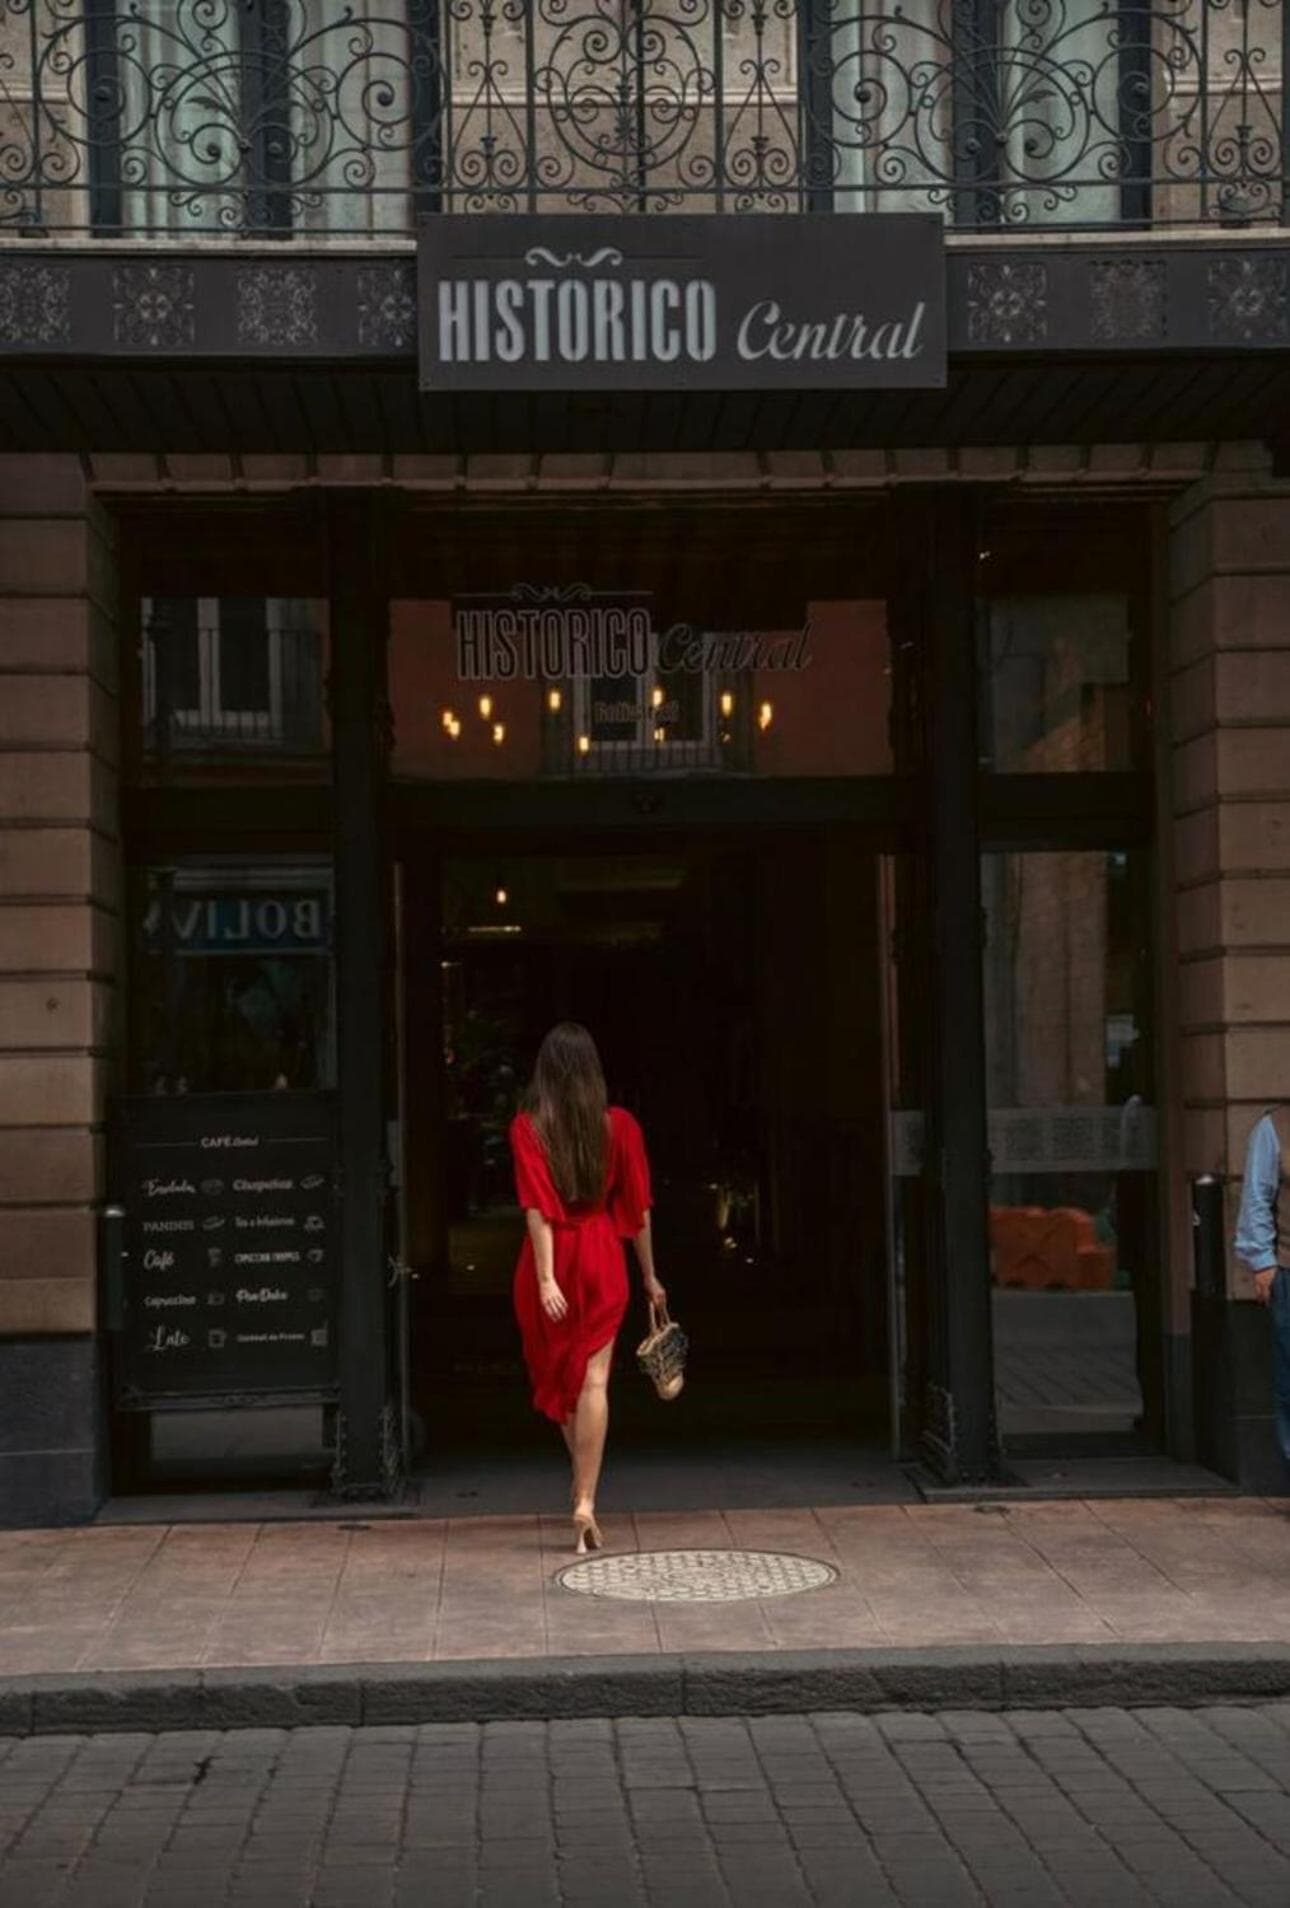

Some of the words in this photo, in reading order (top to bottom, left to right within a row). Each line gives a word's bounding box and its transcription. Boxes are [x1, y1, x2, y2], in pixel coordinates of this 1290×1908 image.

[437, 279, 717, 363] HISTORICO
[736, 300, 926, 361] Central
[456, 607, 652, 680] HISTORICO
[658, 620, 814, 674] Central
